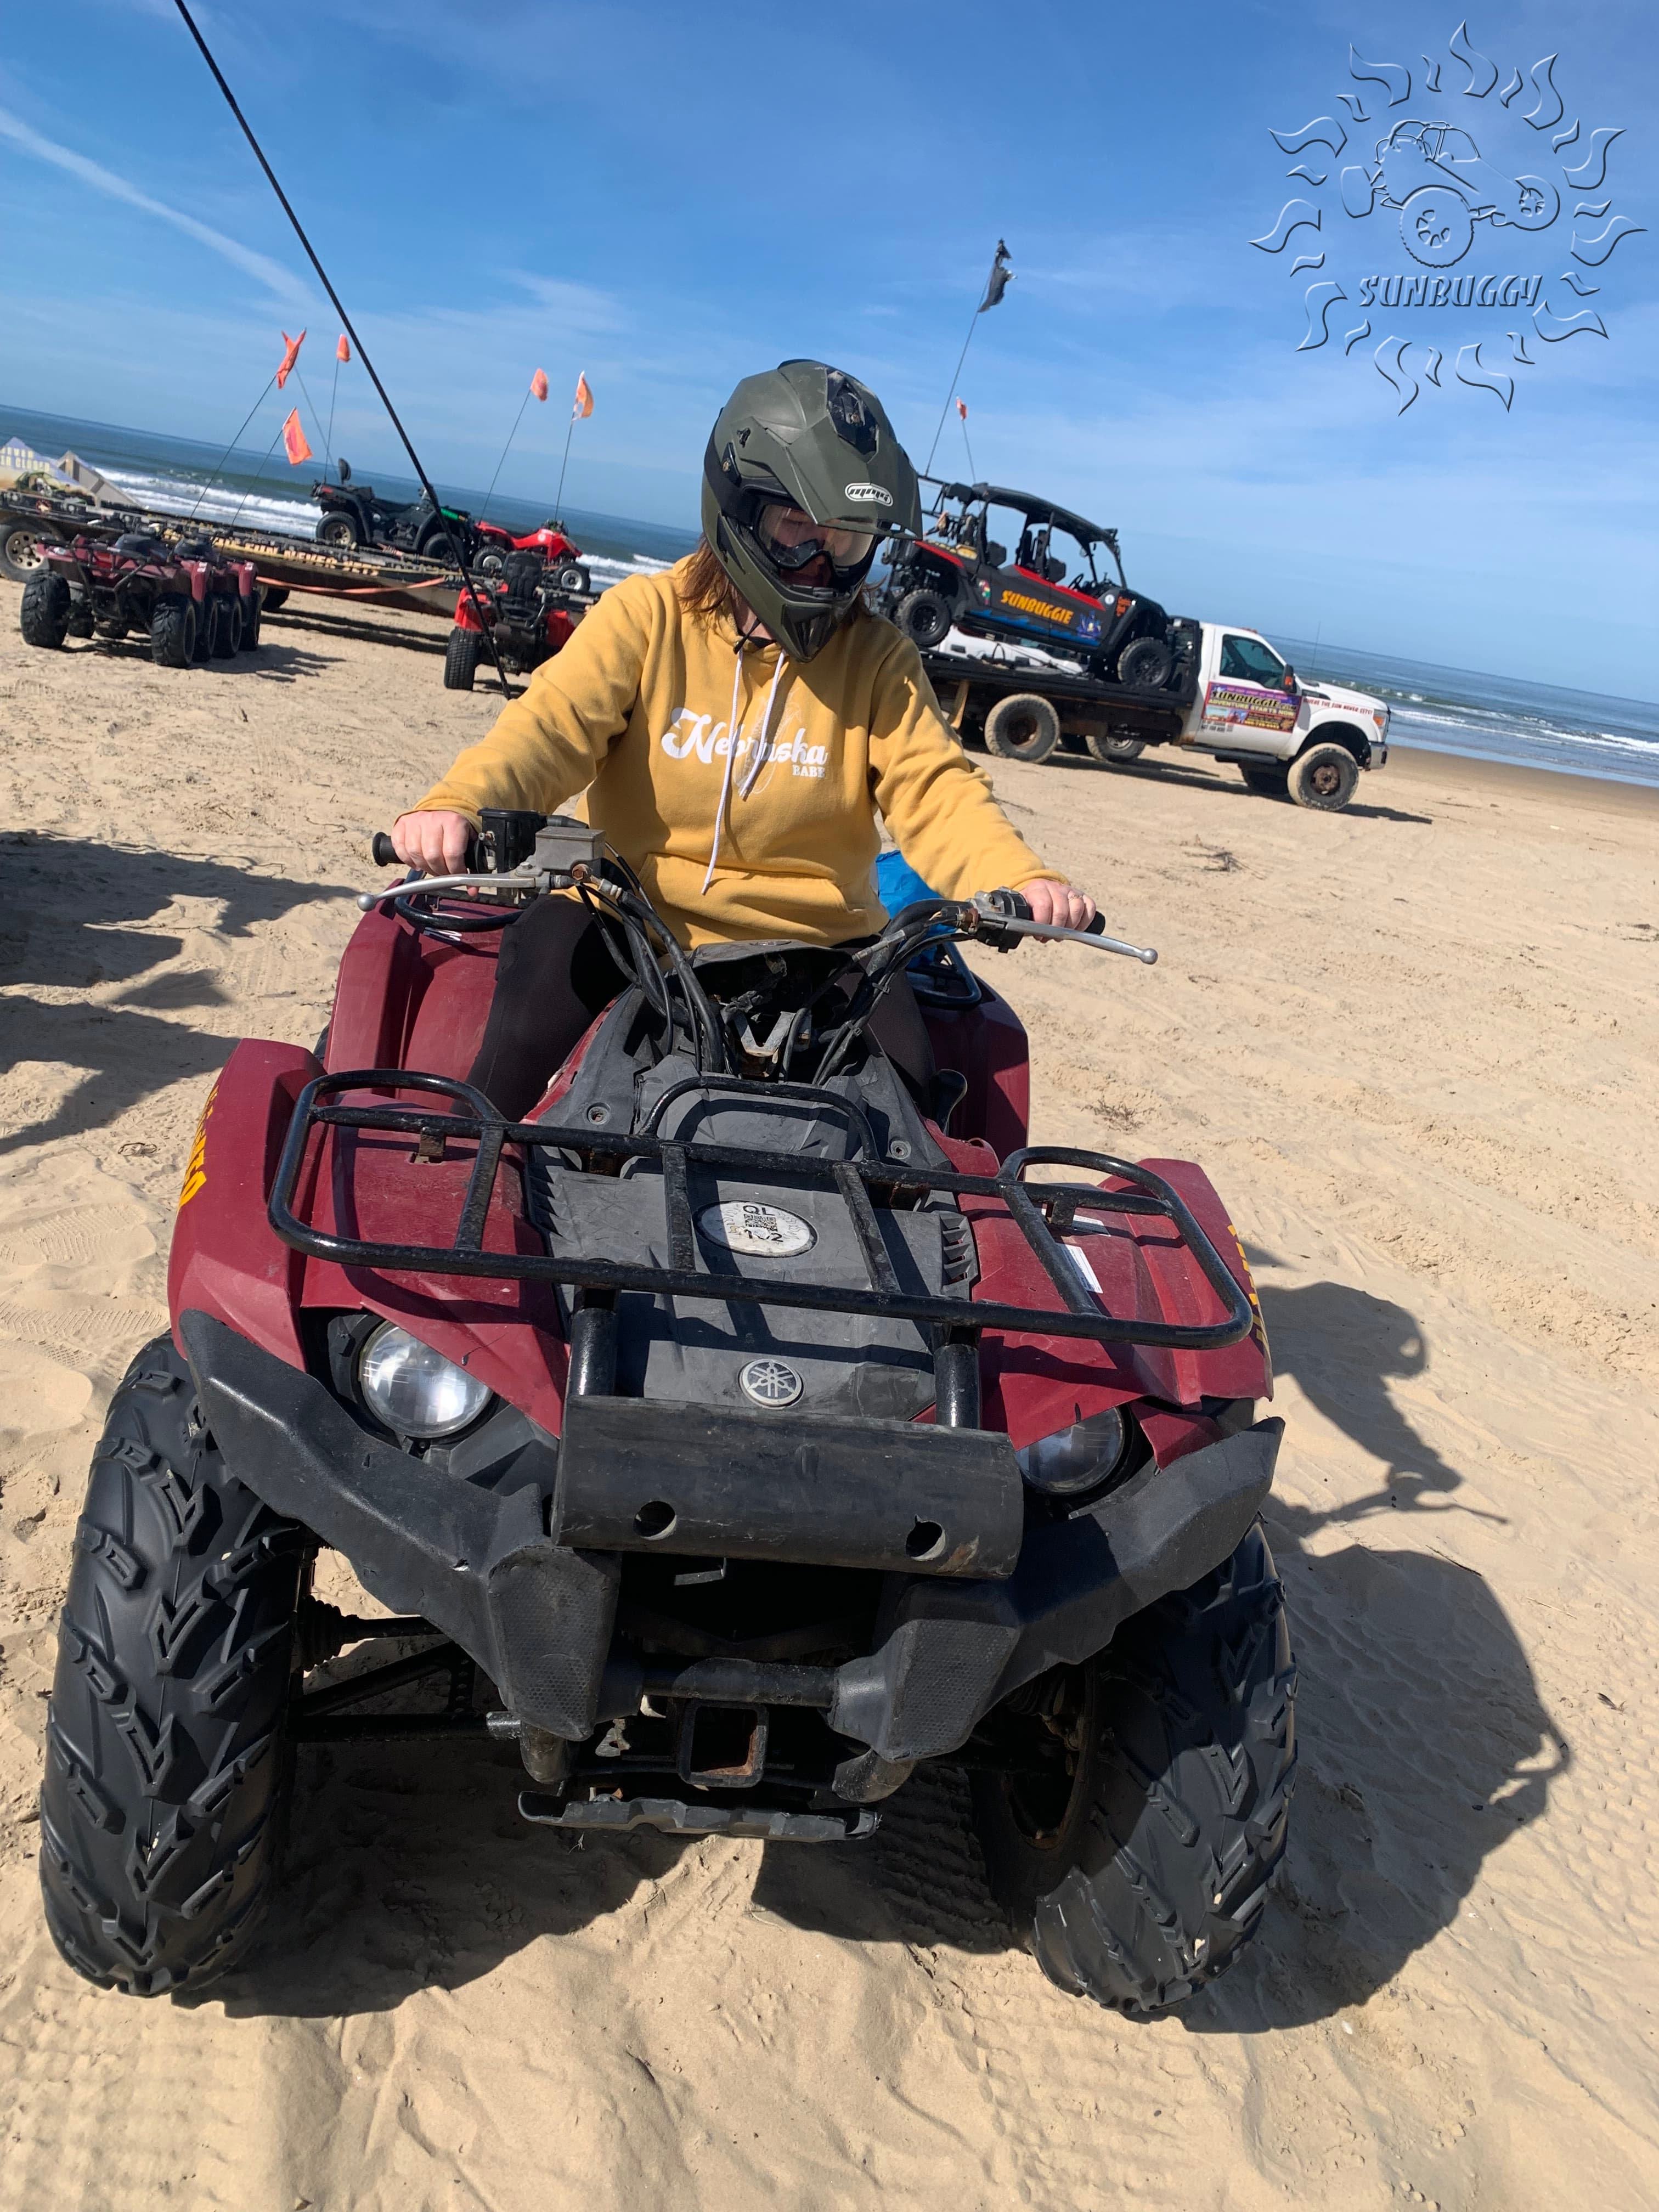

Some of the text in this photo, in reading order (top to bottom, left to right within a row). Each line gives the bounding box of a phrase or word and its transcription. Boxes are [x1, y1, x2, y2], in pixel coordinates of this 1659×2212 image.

[1001, 589, 1074, 624] SUNBUGGIE
[1208, 698, 1249, 709] ADVENTURE
[661, 707, 827, 764] Nebraska
[792, 764, 825, 778] BABE
[743, 1205, 775, 1216] QL
[743, 1228, 784, 1243] 12
